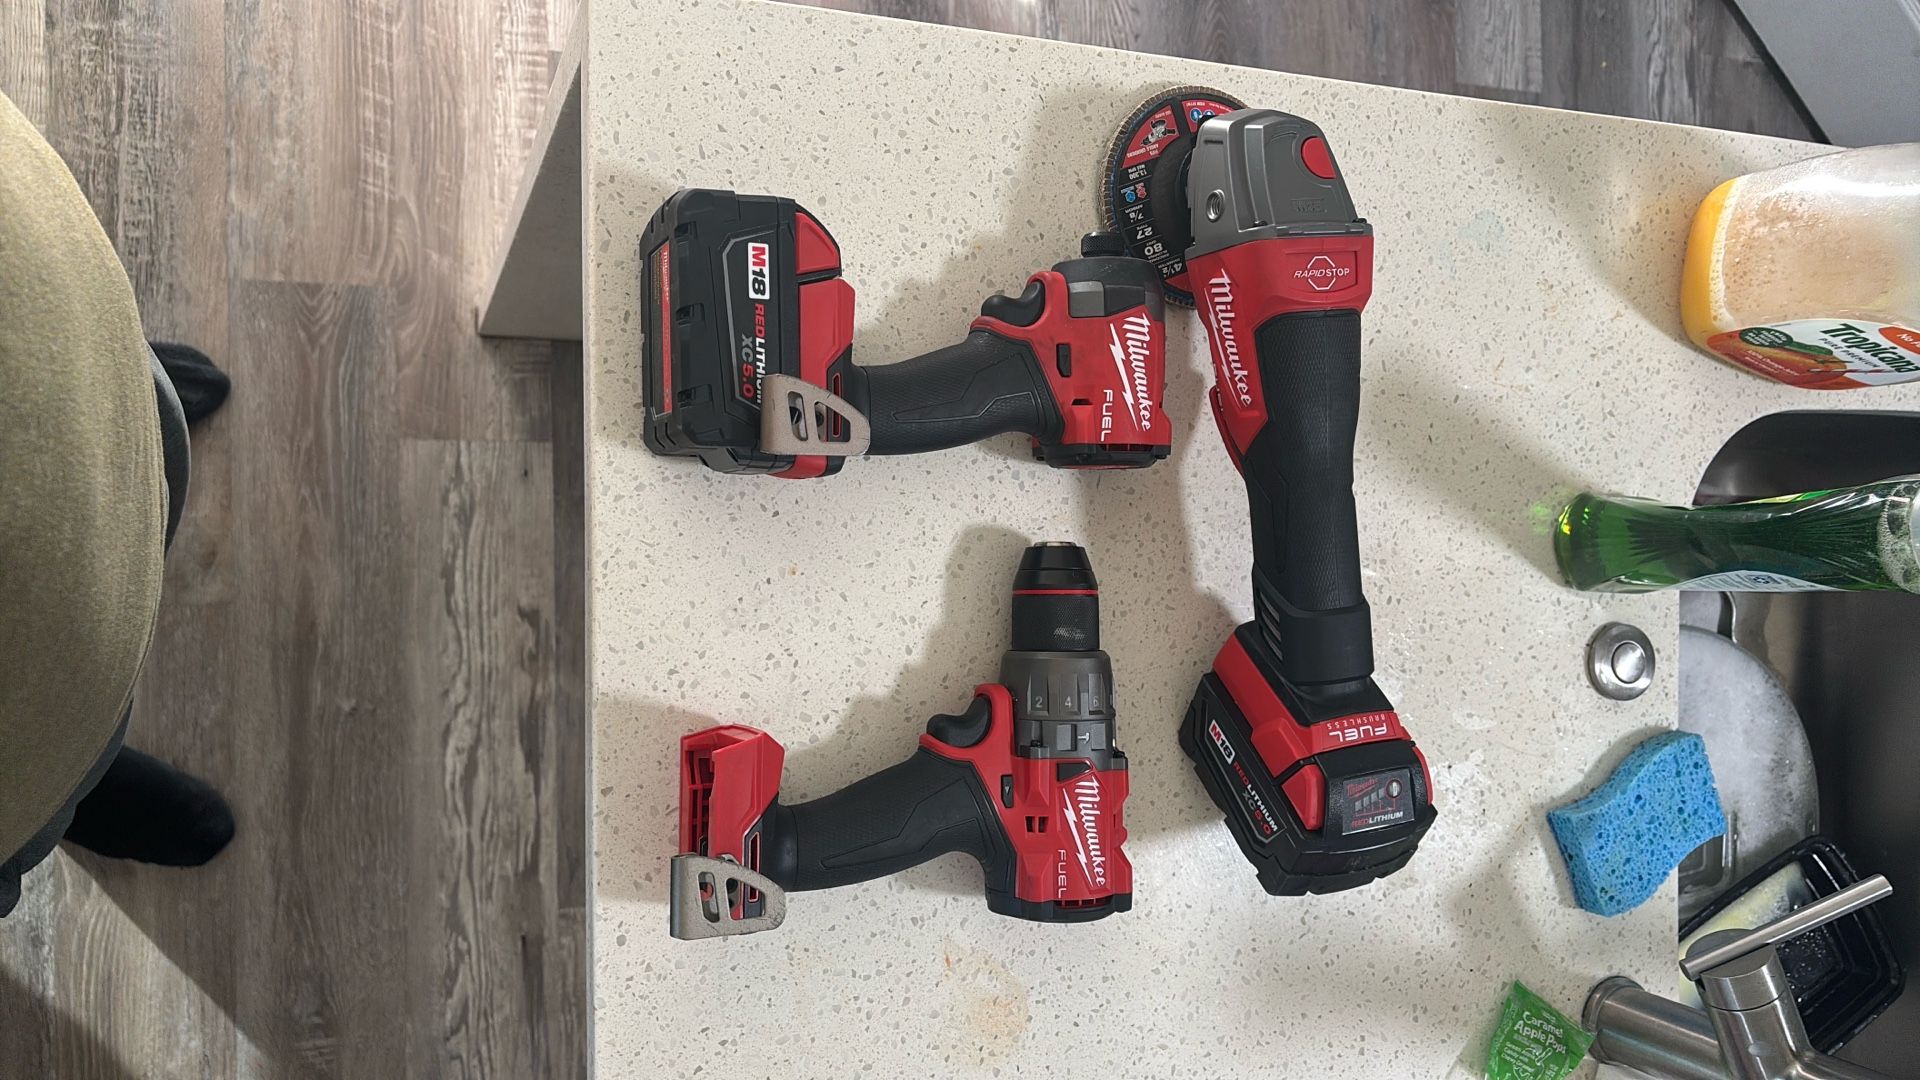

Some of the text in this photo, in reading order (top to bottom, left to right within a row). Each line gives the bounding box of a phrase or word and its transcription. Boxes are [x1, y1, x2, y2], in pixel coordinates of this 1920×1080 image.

[1136, 227, 1153, 240] 27
[1144, 243, 1163, 255] 80
[751, 246, 766, 296] M18
[1208, 268, 1252, 407] Milwaukee
[1818, 337, 1881, 368] PURE PREMIUM
[1820, 323, 1920, 373] Tropicana
[1122, 312, 1153, 431] Milwaukee
[1101, 389, 1113, 442] FUEL
[1035, 696, 1099, 708] 2 4 6
[1327, 713, 1385, 730] BRUSHLESS
[1329, 722, 1387, 742] FUEL
[1210, 723, 1233, 757] M18
[1074, 775, 1106, 887] Milwaukee
[1057, 849, 1067, 898] FUEL
[1514, 1020, 1546, 1042] Apple
[1545, 1034, 1567, 1054] Pops
[1522, 1011, 1563, 1038] Caramel
